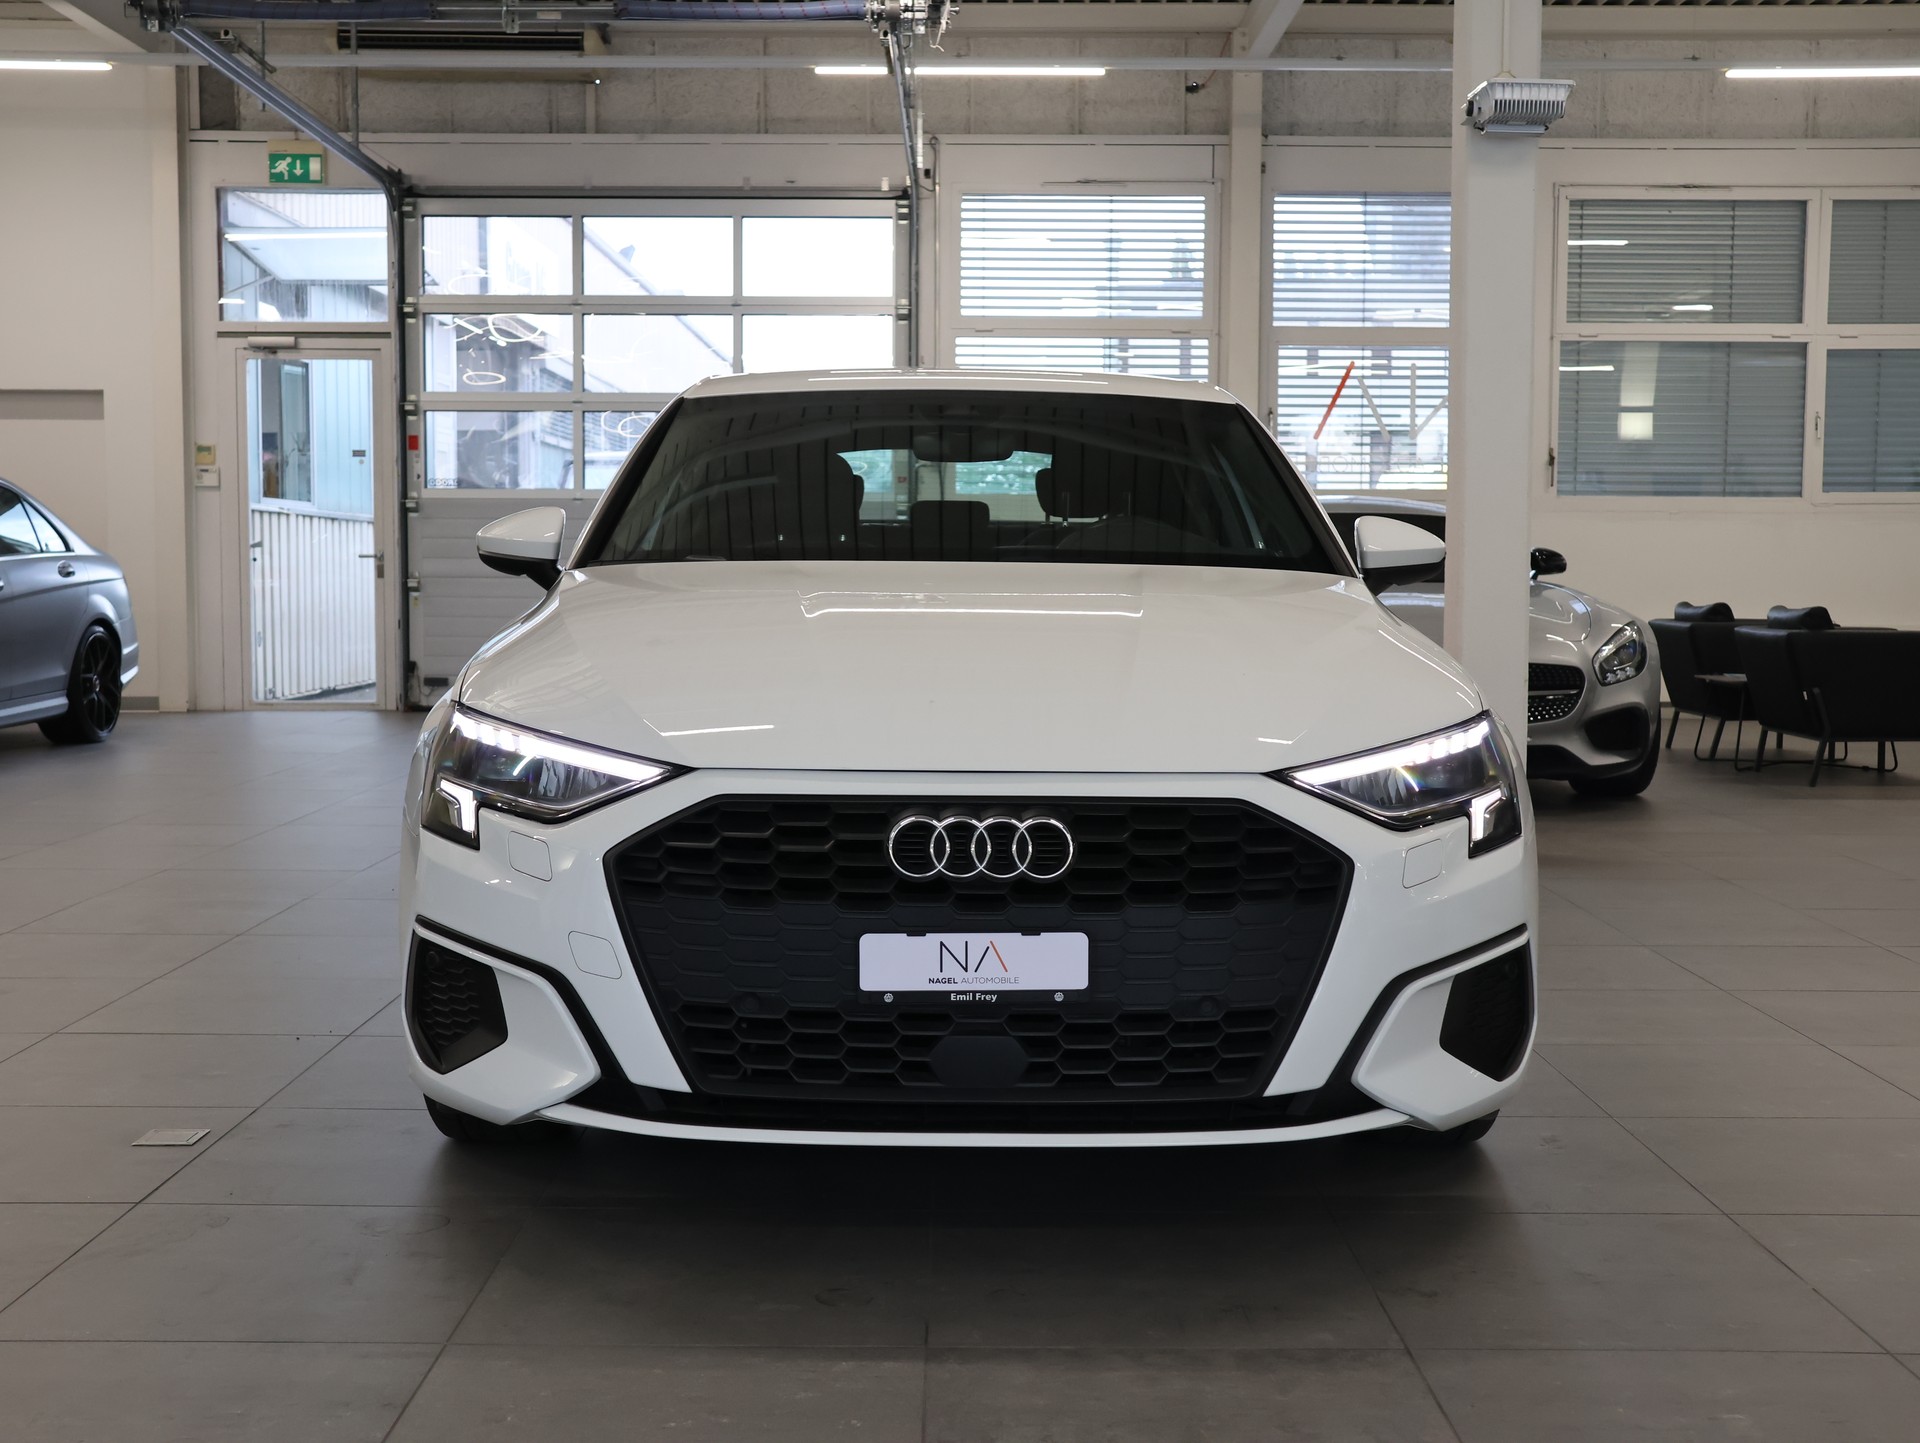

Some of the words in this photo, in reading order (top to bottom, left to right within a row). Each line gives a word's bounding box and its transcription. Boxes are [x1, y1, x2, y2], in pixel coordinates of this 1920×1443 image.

[939, 940, 1008, 973] NA
[928, 977, 958, 985] NAGEL
[961, 976, 1020, 985] AUTOMOBILE
[950, 992, 973, 1001] Emil
[975, 992, 998, 1003] Frey
